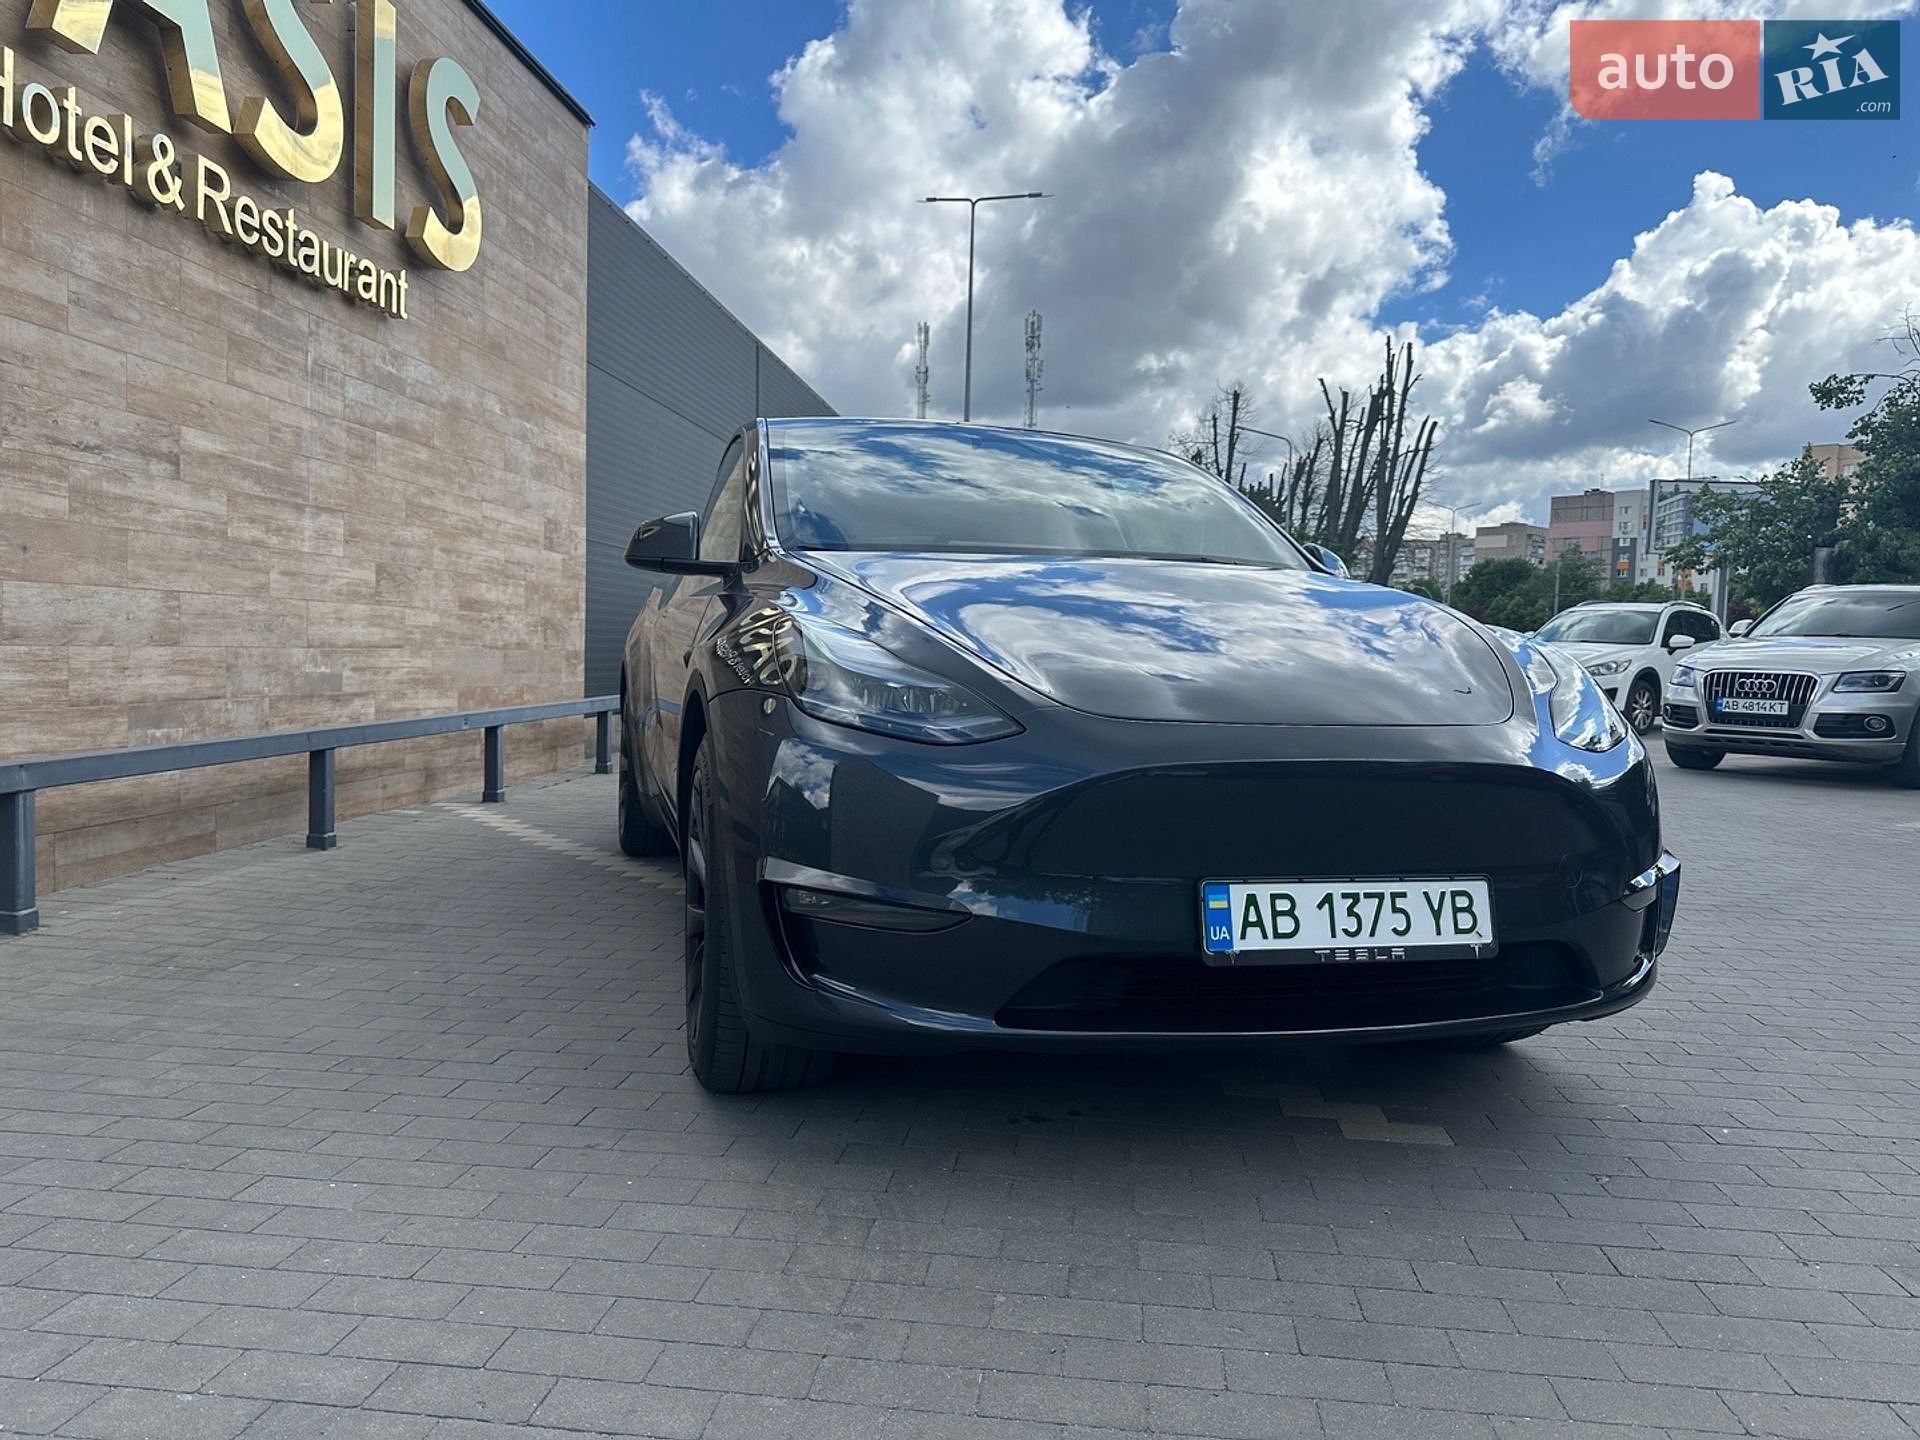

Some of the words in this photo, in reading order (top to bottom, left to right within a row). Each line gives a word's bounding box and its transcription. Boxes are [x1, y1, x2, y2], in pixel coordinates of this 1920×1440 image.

[146, 132, 186, 212] &
[196, 154, 409, 320] Restaurant
[1723, 700, 1739, 711] AB
[1742, 701, 1767, 712] 4814
[1768, 702, 1786, 713] KT
[1239, 893, 1300, 940] AB
[1315, 890, 1412, 938] 1375
[1422, 889, 1479, 936] YB
[1210, 925, 1230, 941] UA
[1314, 947, 1405, 962] TESLA
